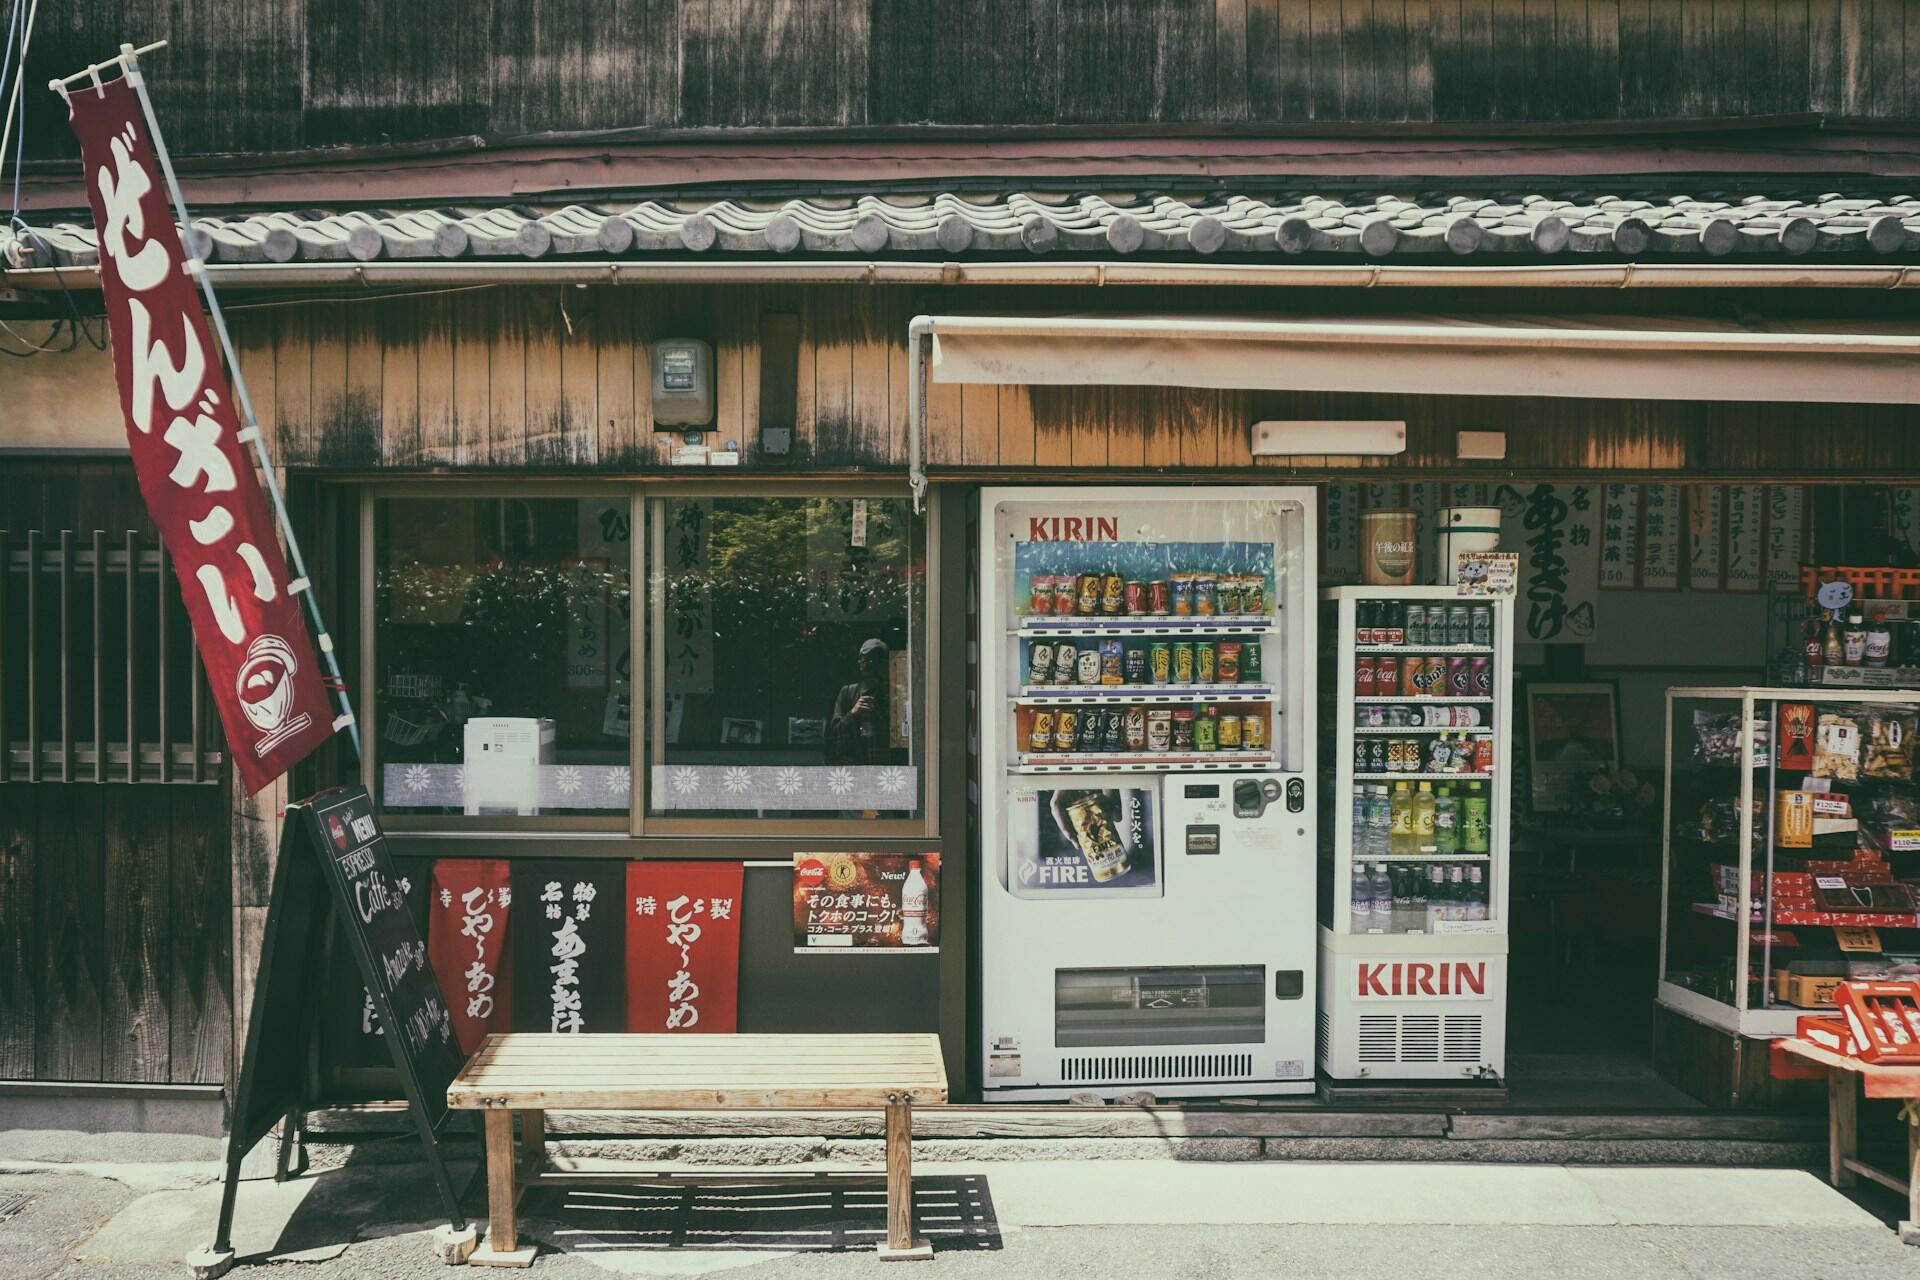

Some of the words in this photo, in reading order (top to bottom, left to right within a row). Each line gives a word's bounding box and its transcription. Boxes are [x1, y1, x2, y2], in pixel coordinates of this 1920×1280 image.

[98, 121, 277, 644] ぜんざい
[1029, 516, 1118, 542] KIRIN
[1570, 486, 1591, 547] 名物
[1375, 541, 1414, 553] 午後の紅茶
[1523, 484, 1568, 641] あまざけ
[1249, 647, 1259, 667] 生茶
[351, 814, 377, 843] MENU
[1129, 797, 1144, 849] 心に火を。
[342, 847, 375, 880] ESPRESSO
[881, 871, 906, 880] New!
[1040, 866, 1088, 883] FIRE
[807, 893, 897, 908] その食事にも。
[1358, 962, 1486, 996] KIRIN
